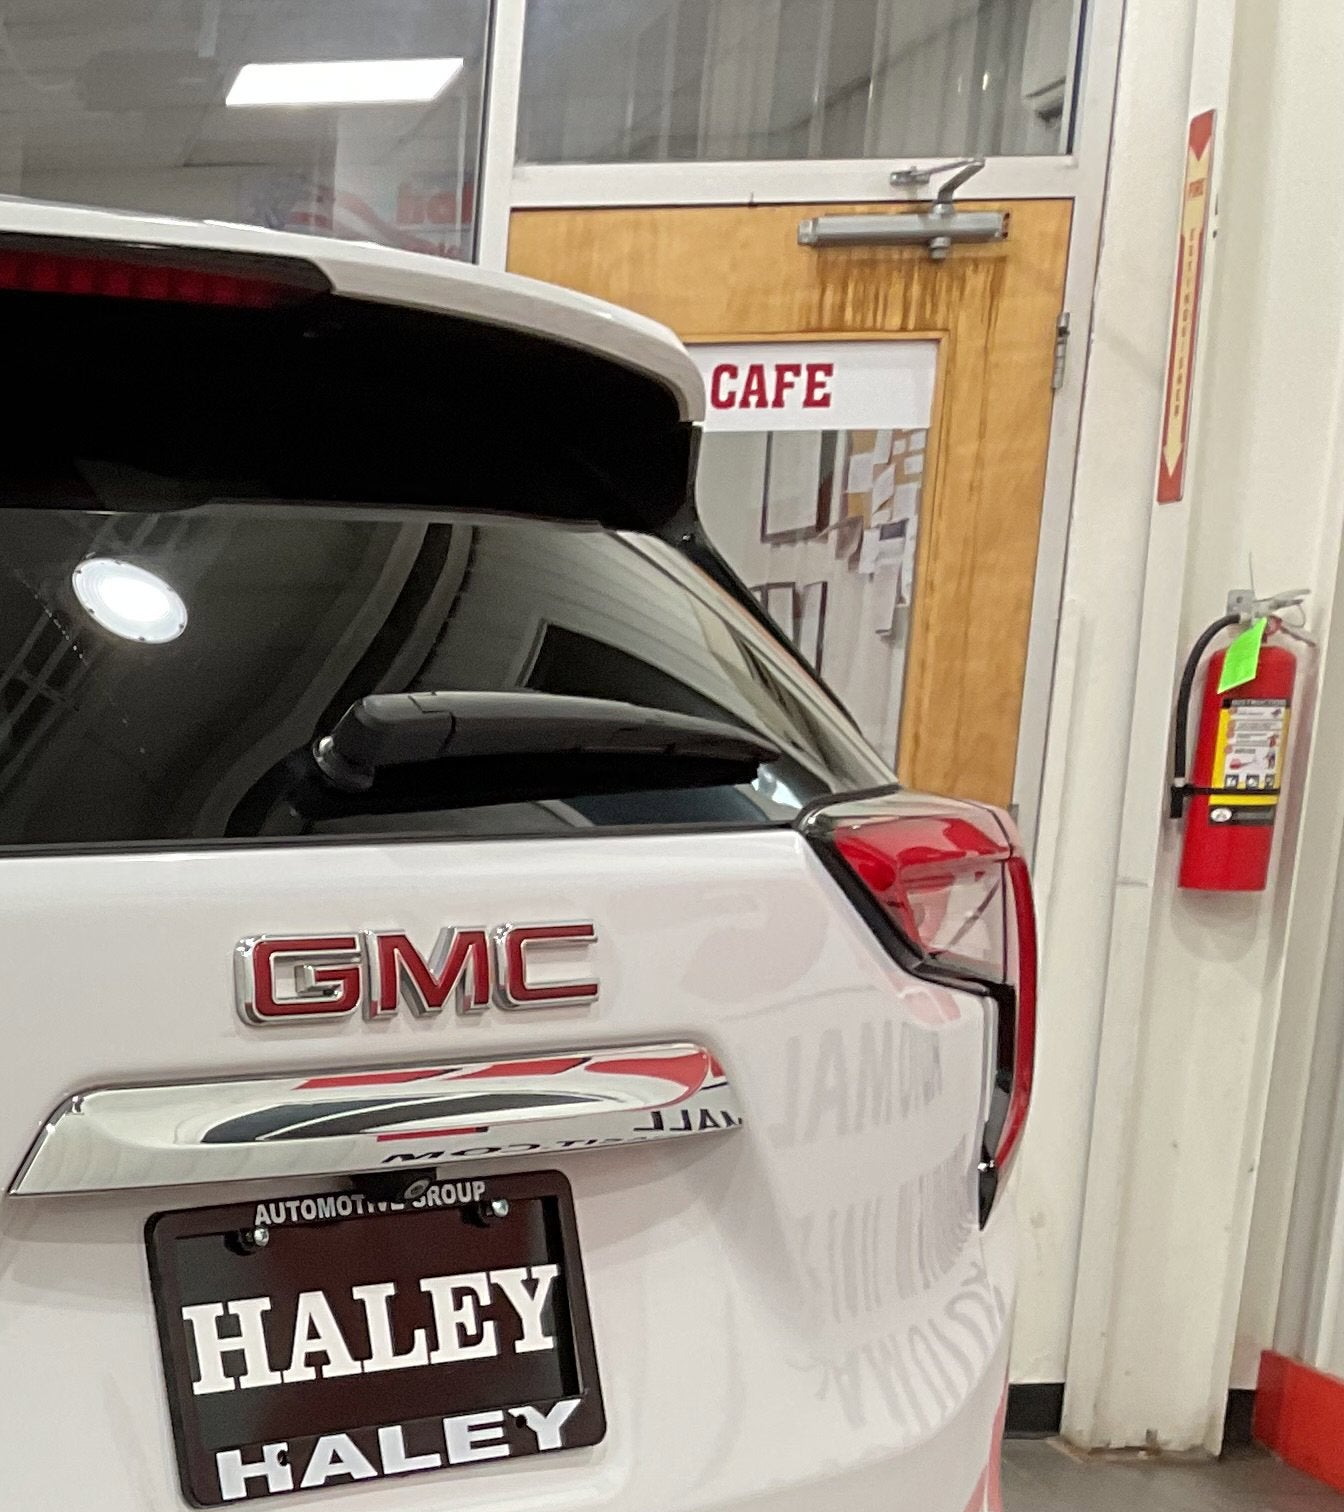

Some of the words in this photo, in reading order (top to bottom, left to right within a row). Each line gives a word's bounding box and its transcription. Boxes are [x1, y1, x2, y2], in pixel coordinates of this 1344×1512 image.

[710, 362, 834, 410] CAFE
[233, 918, 601, 1027] GMC
[181, 1263, 559, 1396] HALEY
[215, 1398, 581, 1500] HALEY
